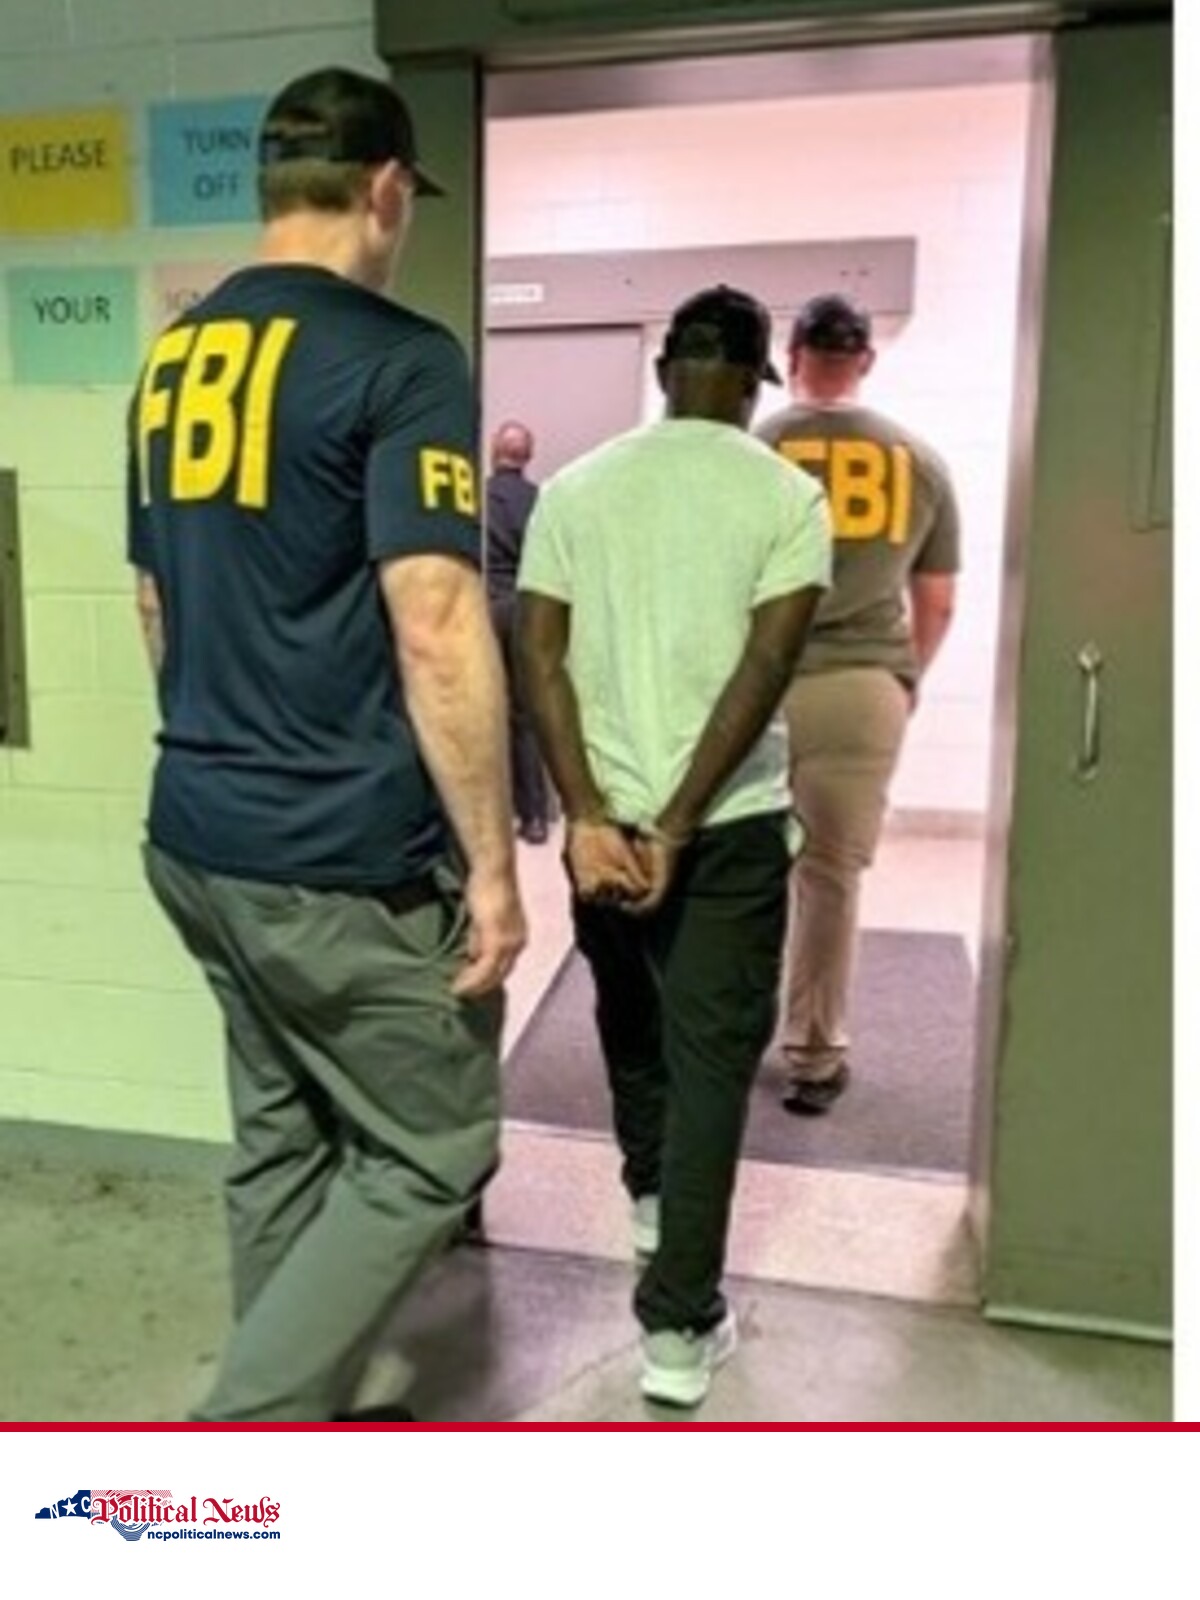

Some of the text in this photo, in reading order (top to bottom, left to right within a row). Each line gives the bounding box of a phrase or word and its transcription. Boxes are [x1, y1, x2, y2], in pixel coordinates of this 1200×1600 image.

[10, 139, 106, 174] PLEASE
[181, 126, 250, 155] TURN
[33, 296, 111, 325] YOUR
[138, 318, 297, 508] FBI
